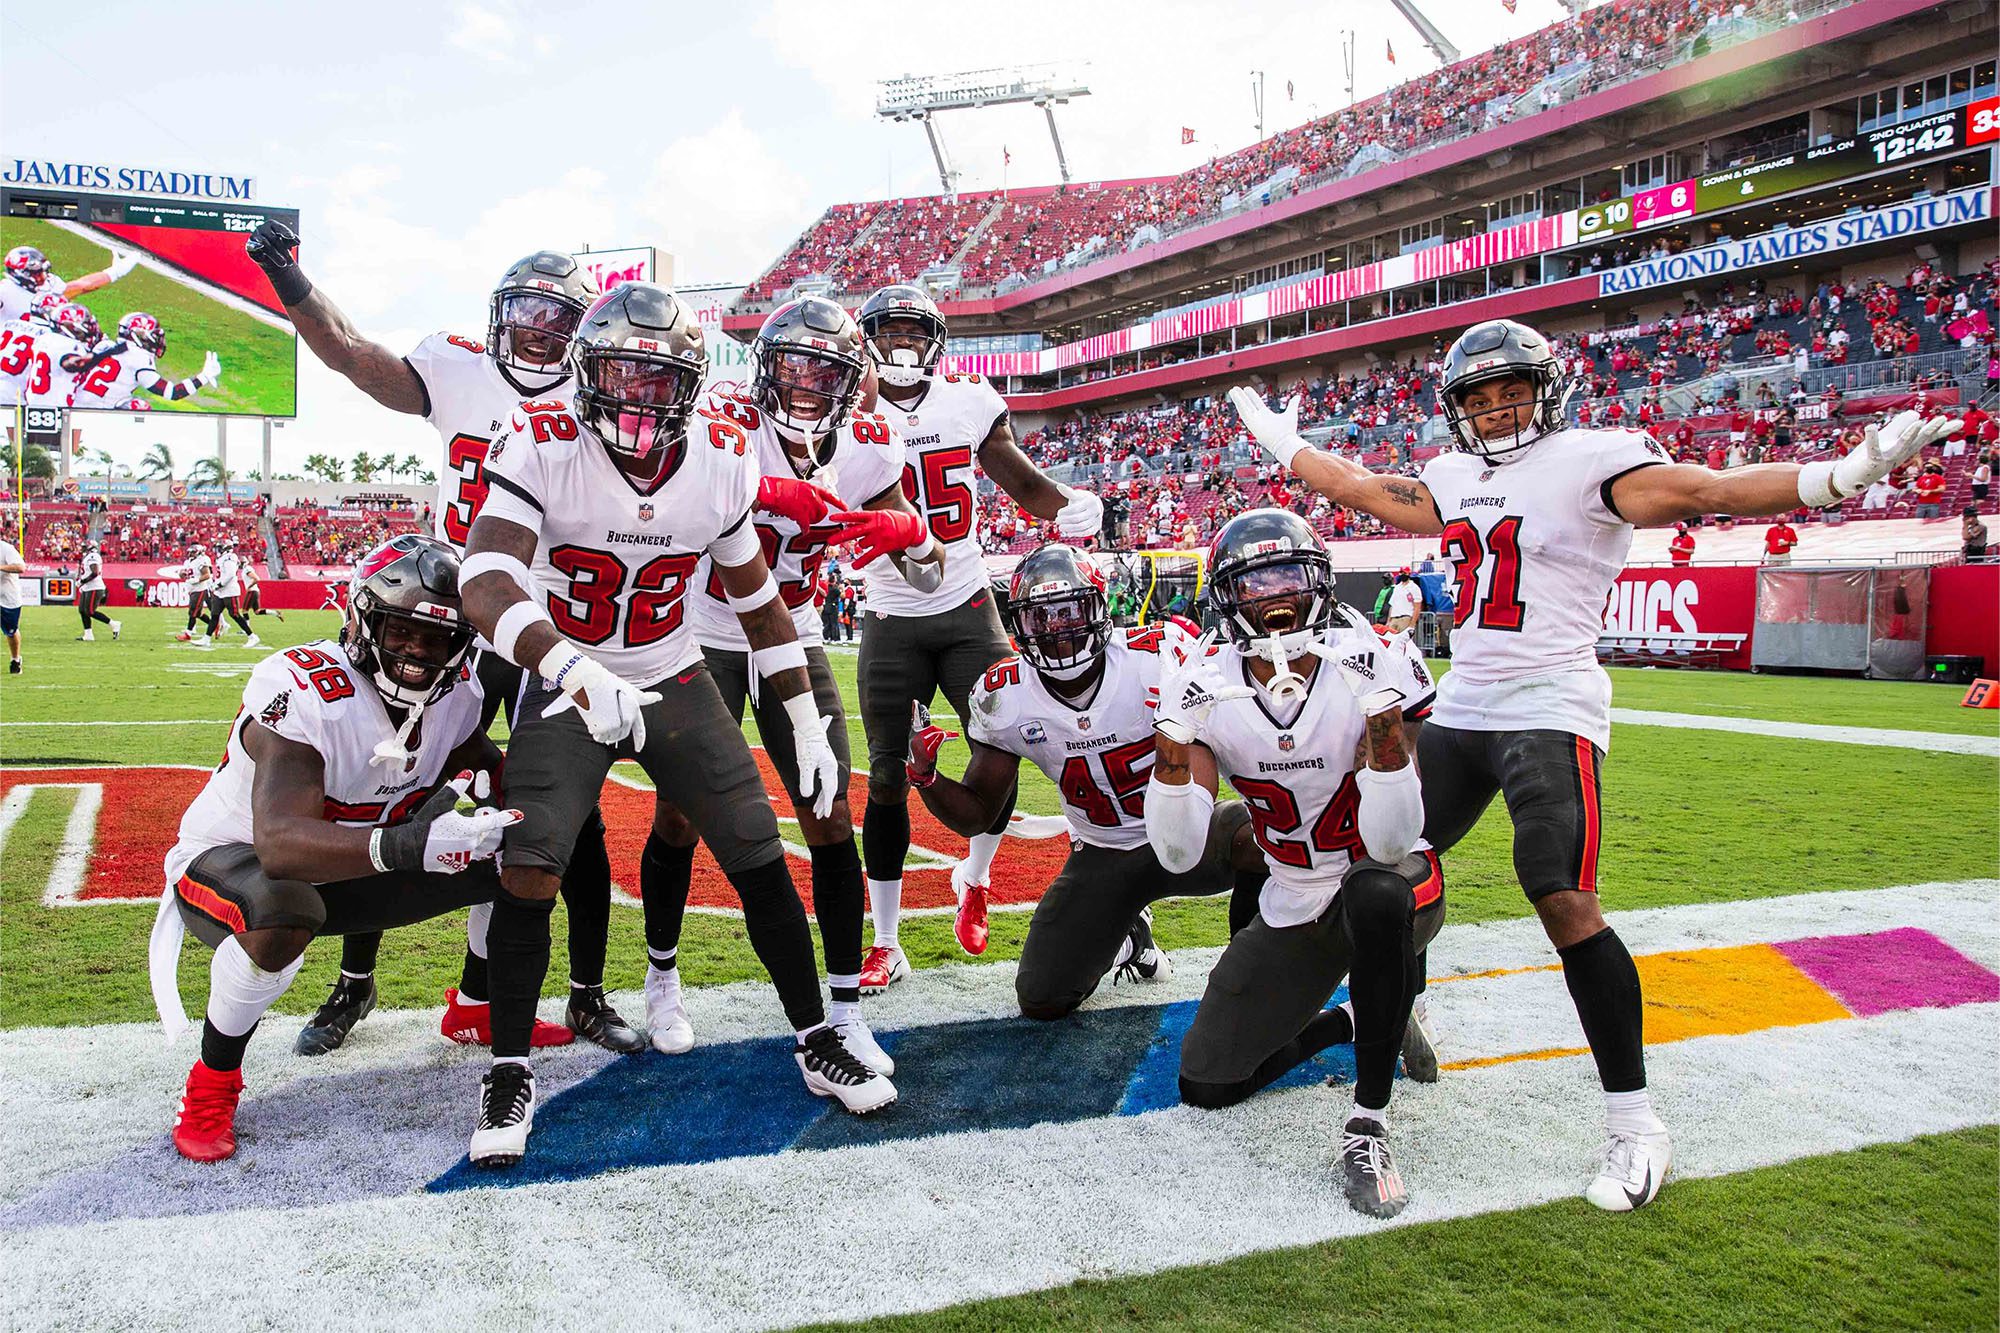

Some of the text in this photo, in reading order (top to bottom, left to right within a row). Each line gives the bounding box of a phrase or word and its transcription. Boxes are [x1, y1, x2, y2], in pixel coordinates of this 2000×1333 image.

[1868, 111, 1957, 143] 2ND QUARTER
[1806, 139, 1855, 160] BALL ON
[1872, 124, 1955, 164] 12:42
[3, 159, 252, 199] JAMES STADIUM
[1702, 173, 1733, 187] DOWN
[1733, 170, 1743, 179] &
[1743, 156, 1795, 178] DISTANCE
[1670, 187, 1687, 208] 6
[1740, 180, 1755, 194] &
[1604, 202, 1629, 225] 10
[1601, 246, 1729, 294] RAYMOND
[1732, 228, 1828, 269] JAMES
[1836, 190, 1987, 246] STADIUM
[706, 342, 748, 366] lix
[28, 410, 55, 427] 33
[1460, 497, 1506, 510] BUCCANEERS
[606, 530, 673, 548] BUCCANEERS
[1440, 515, 1526, 632] 31
[49, 579, 71, 596] 33
[547, 543, 701, 648] 32
[1340, 658, 1376, 681] adidas
[1181, 692, 1215, 710] adidas
[1965, 682, 1990, 705] G
[1065, 733, 1118, 751] BUCCANEERS
[1258, 757, 1325, 773] BUCCANEERS
[1059, 738, 1157, 828] 45
[1231, 771, 1367, 870] 24
[436, 853, 466, 872] adida
